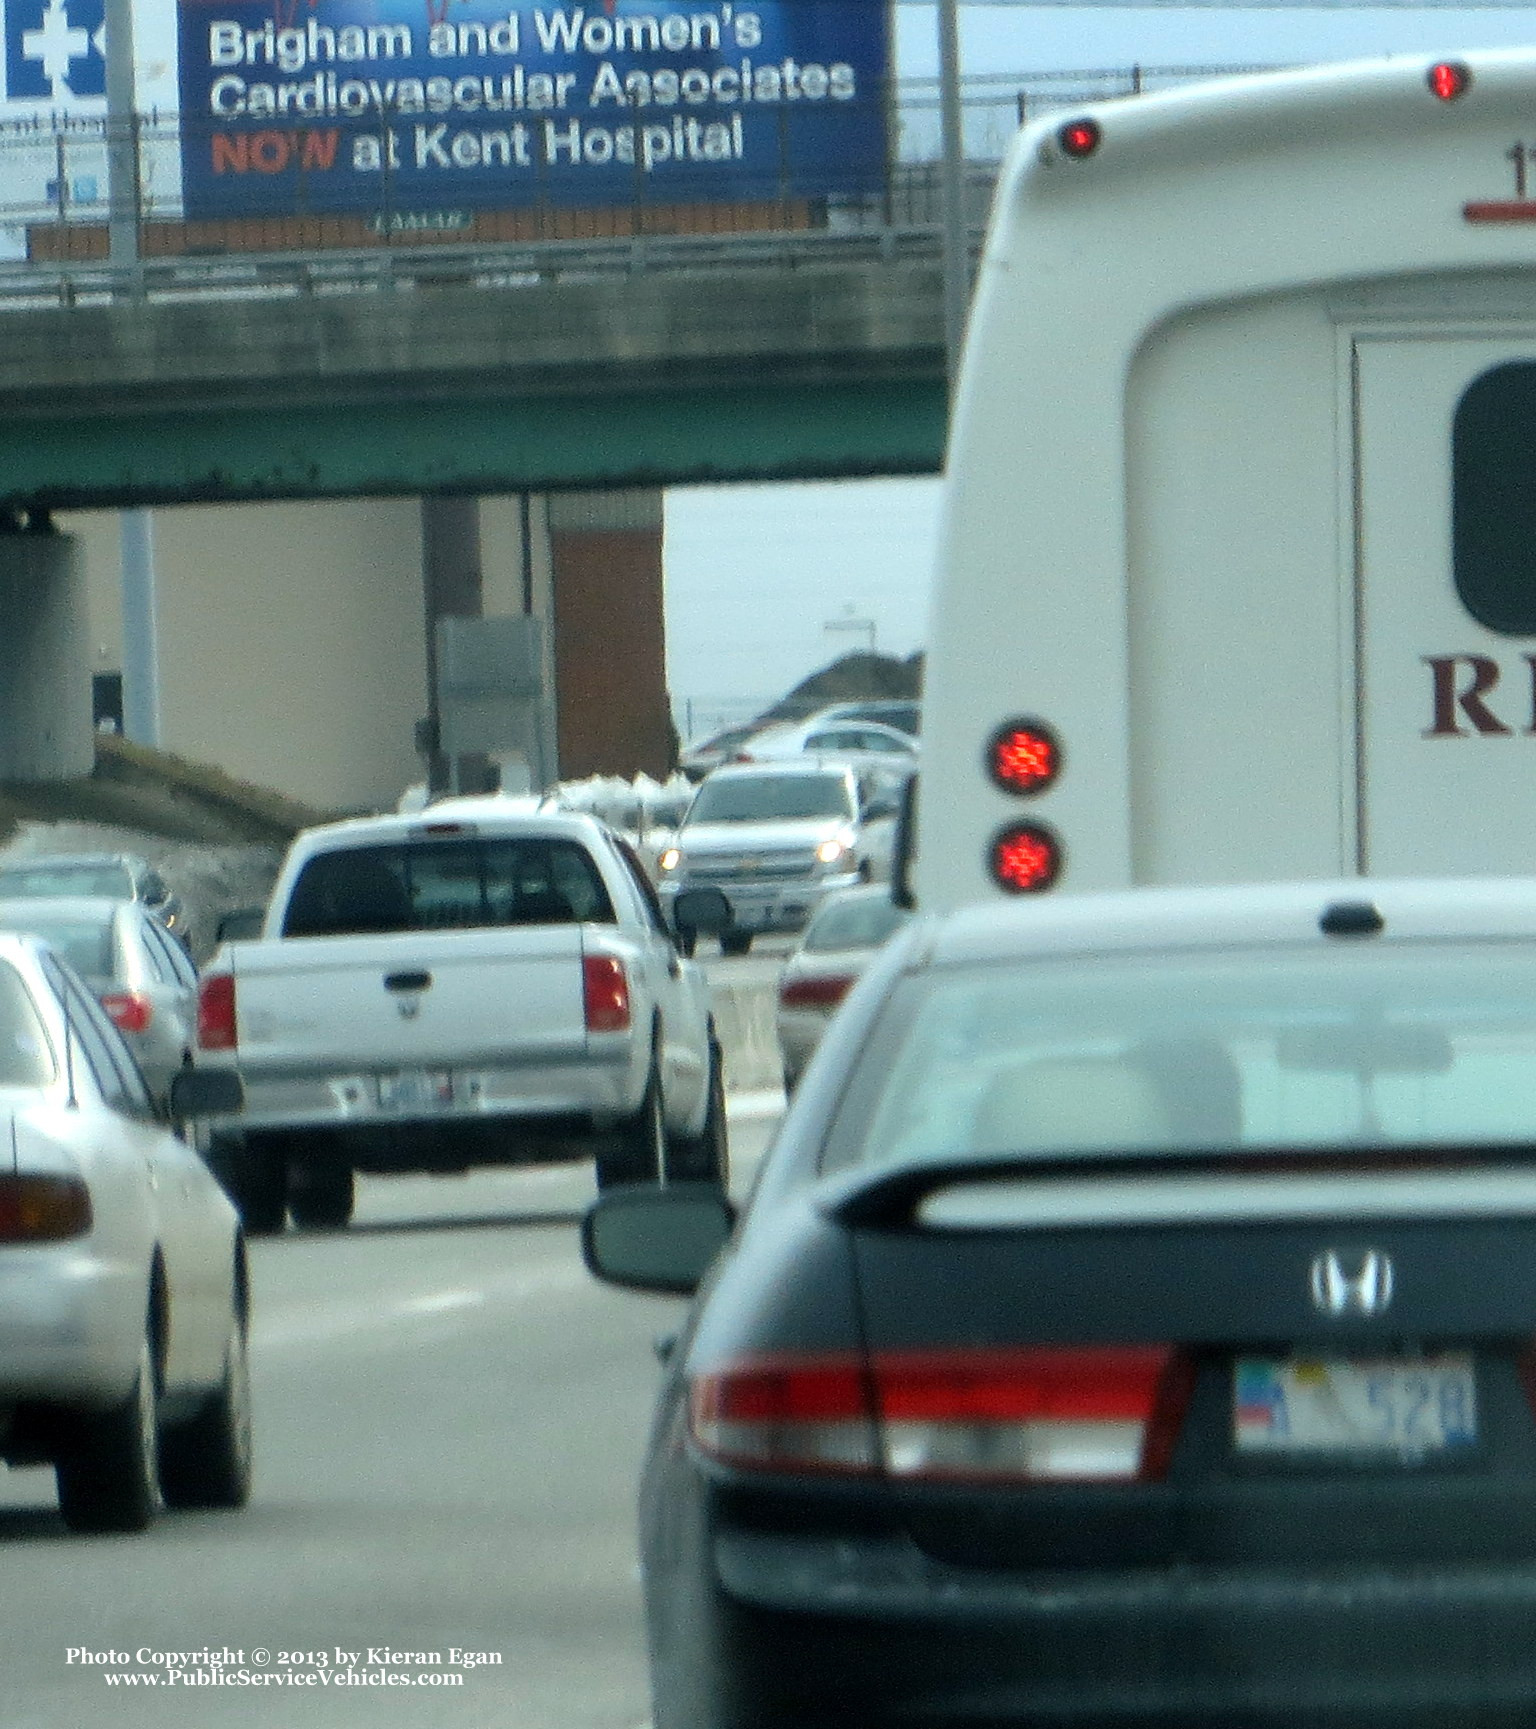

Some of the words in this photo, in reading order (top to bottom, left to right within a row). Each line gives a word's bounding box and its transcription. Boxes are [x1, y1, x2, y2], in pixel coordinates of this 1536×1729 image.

[208, 16, 413, 73] Brigham
[428, 9, 520, 59] and
[533, 2, 763, 54] Women's
[208, 62, 577, 120] Cardiovascular
[588, 56, 856, 108] Associates
[210, 128, 341, 174] NOW
[352, 128, 402, 171] at
[414, 121, 532, 169] Kent
[543, 111, 744, 172] Hospital
